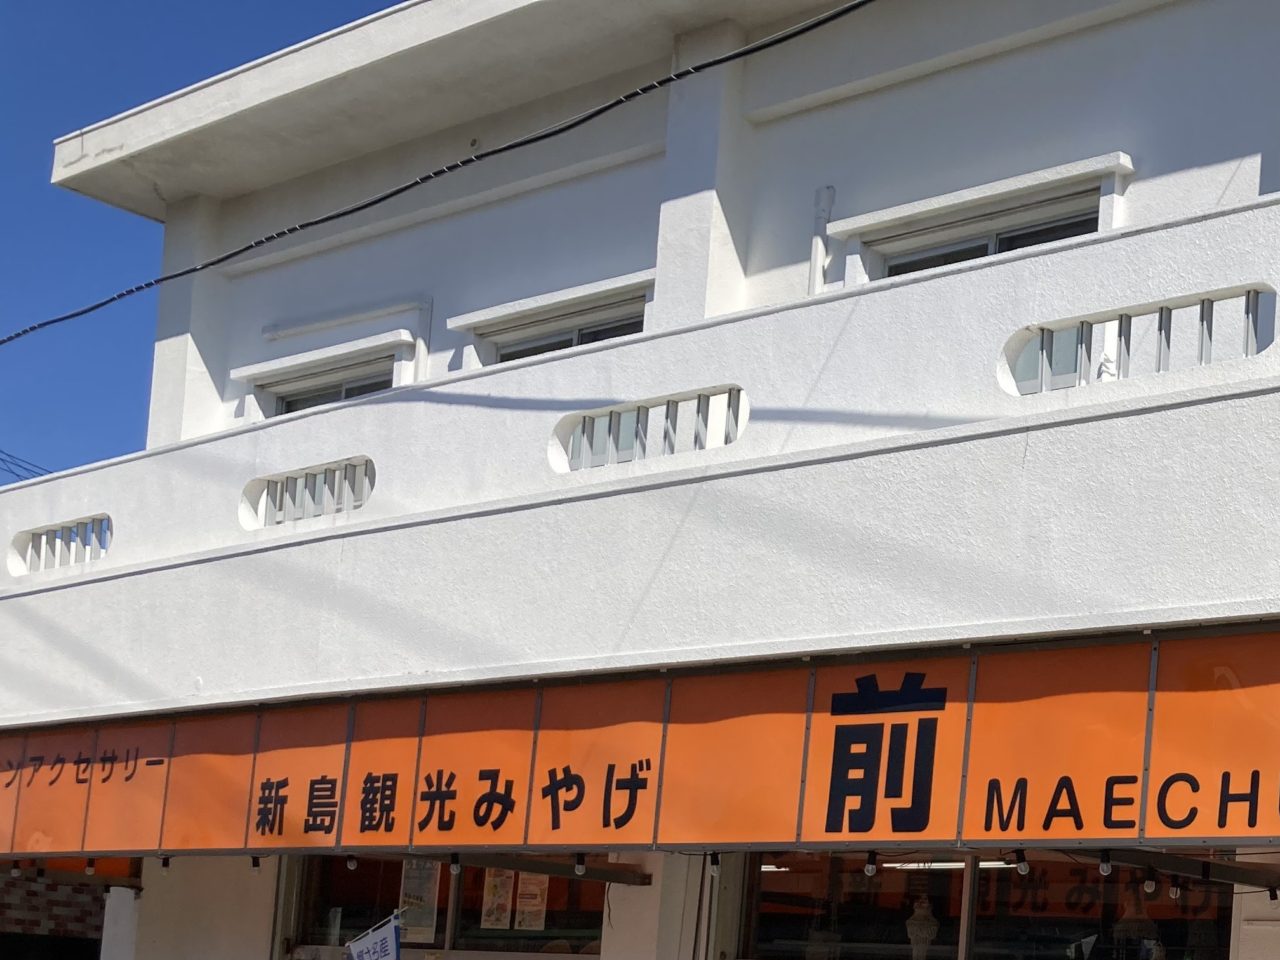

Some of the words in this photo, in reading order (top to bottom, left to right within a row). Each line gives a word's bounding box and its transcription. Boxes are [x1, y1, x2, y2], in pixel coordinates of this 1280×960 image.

[255, 757, 651, 837] 新島観光みやげ
[824, 672, 948, 833] 前
